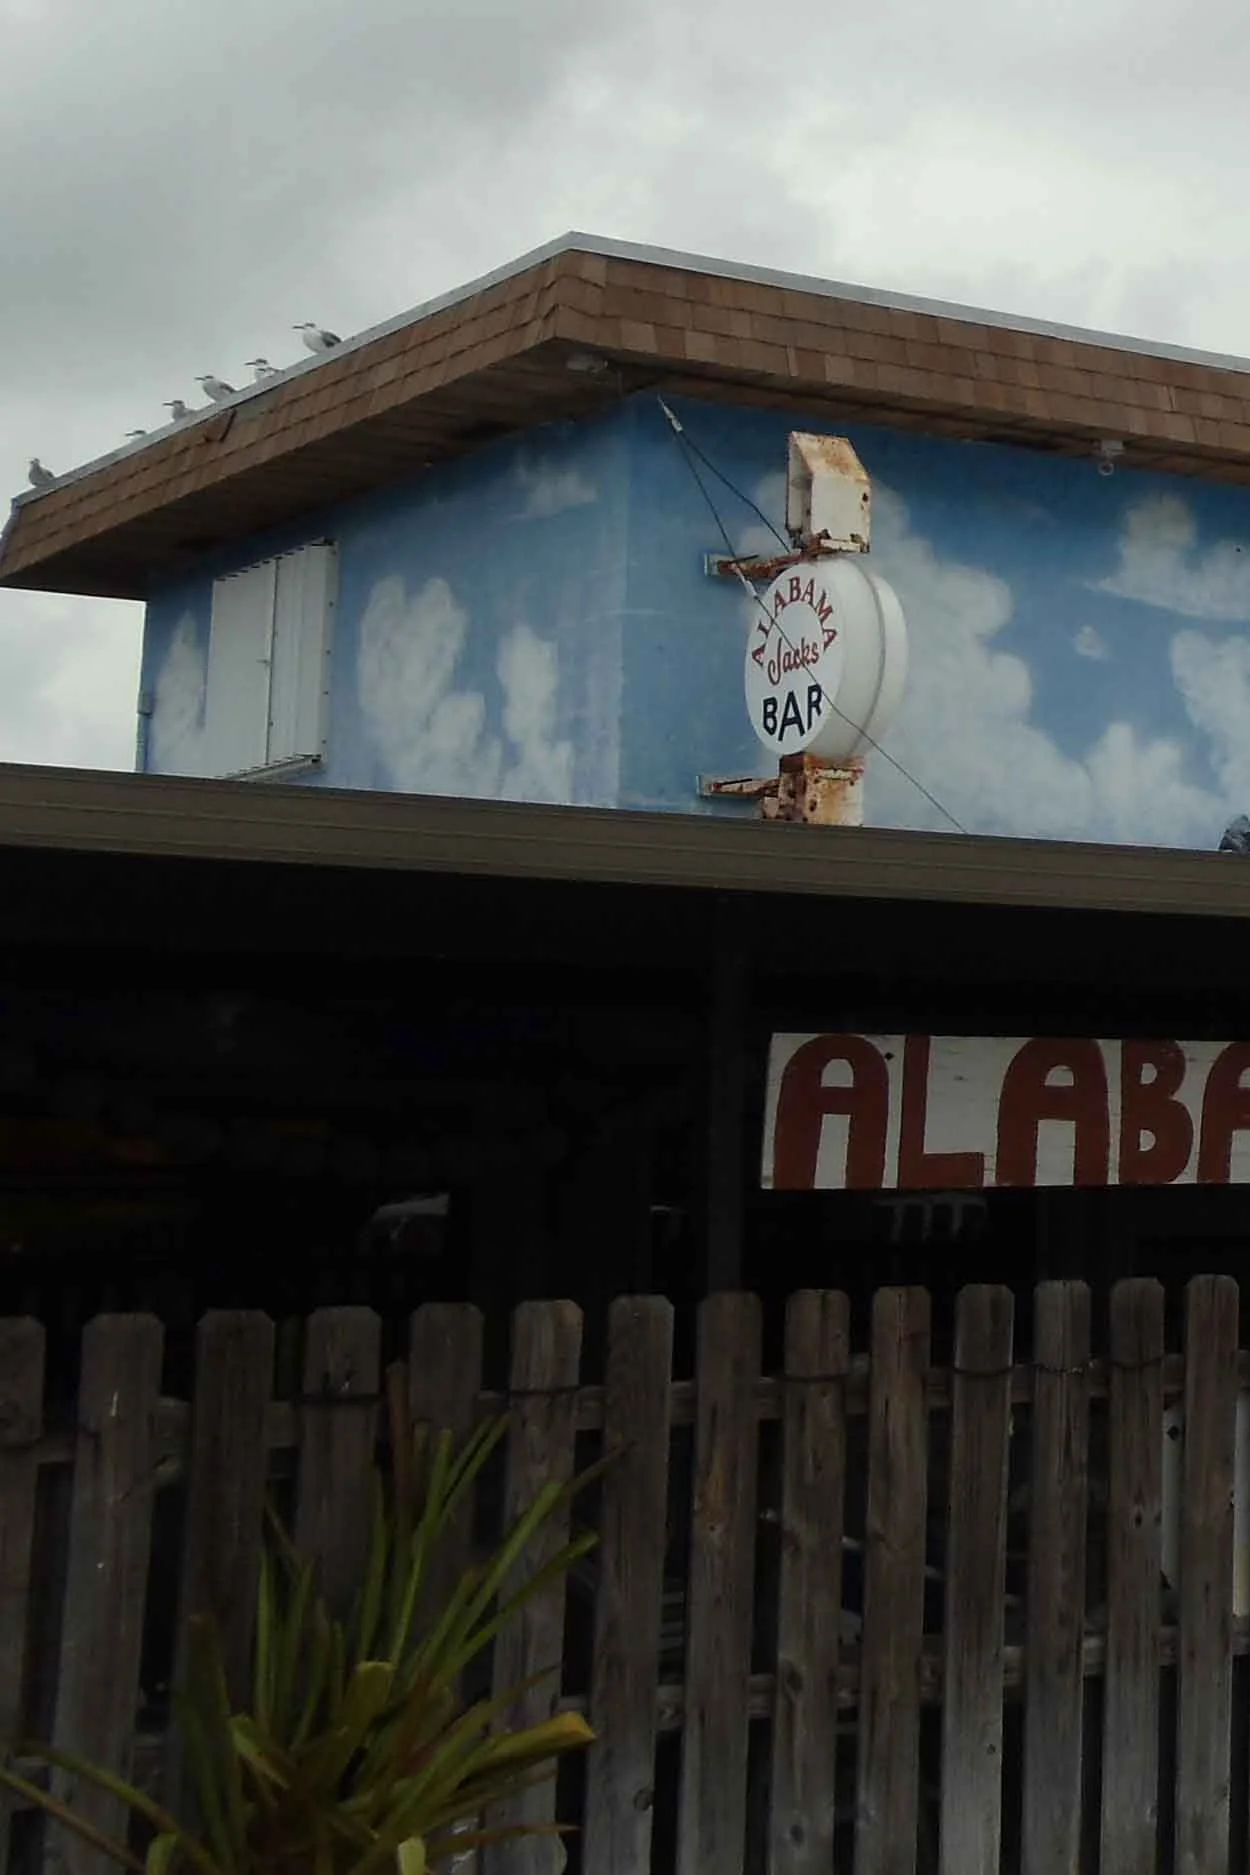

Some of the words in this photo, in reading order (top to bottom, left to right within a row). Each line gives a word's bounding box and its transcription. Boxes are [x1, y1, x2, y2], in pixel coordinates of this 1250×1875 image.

[752, 575, 838, 666] ALABAMA
[767, 637, 820, 686] Jacks
[762, 684, 823, 742] BAR
